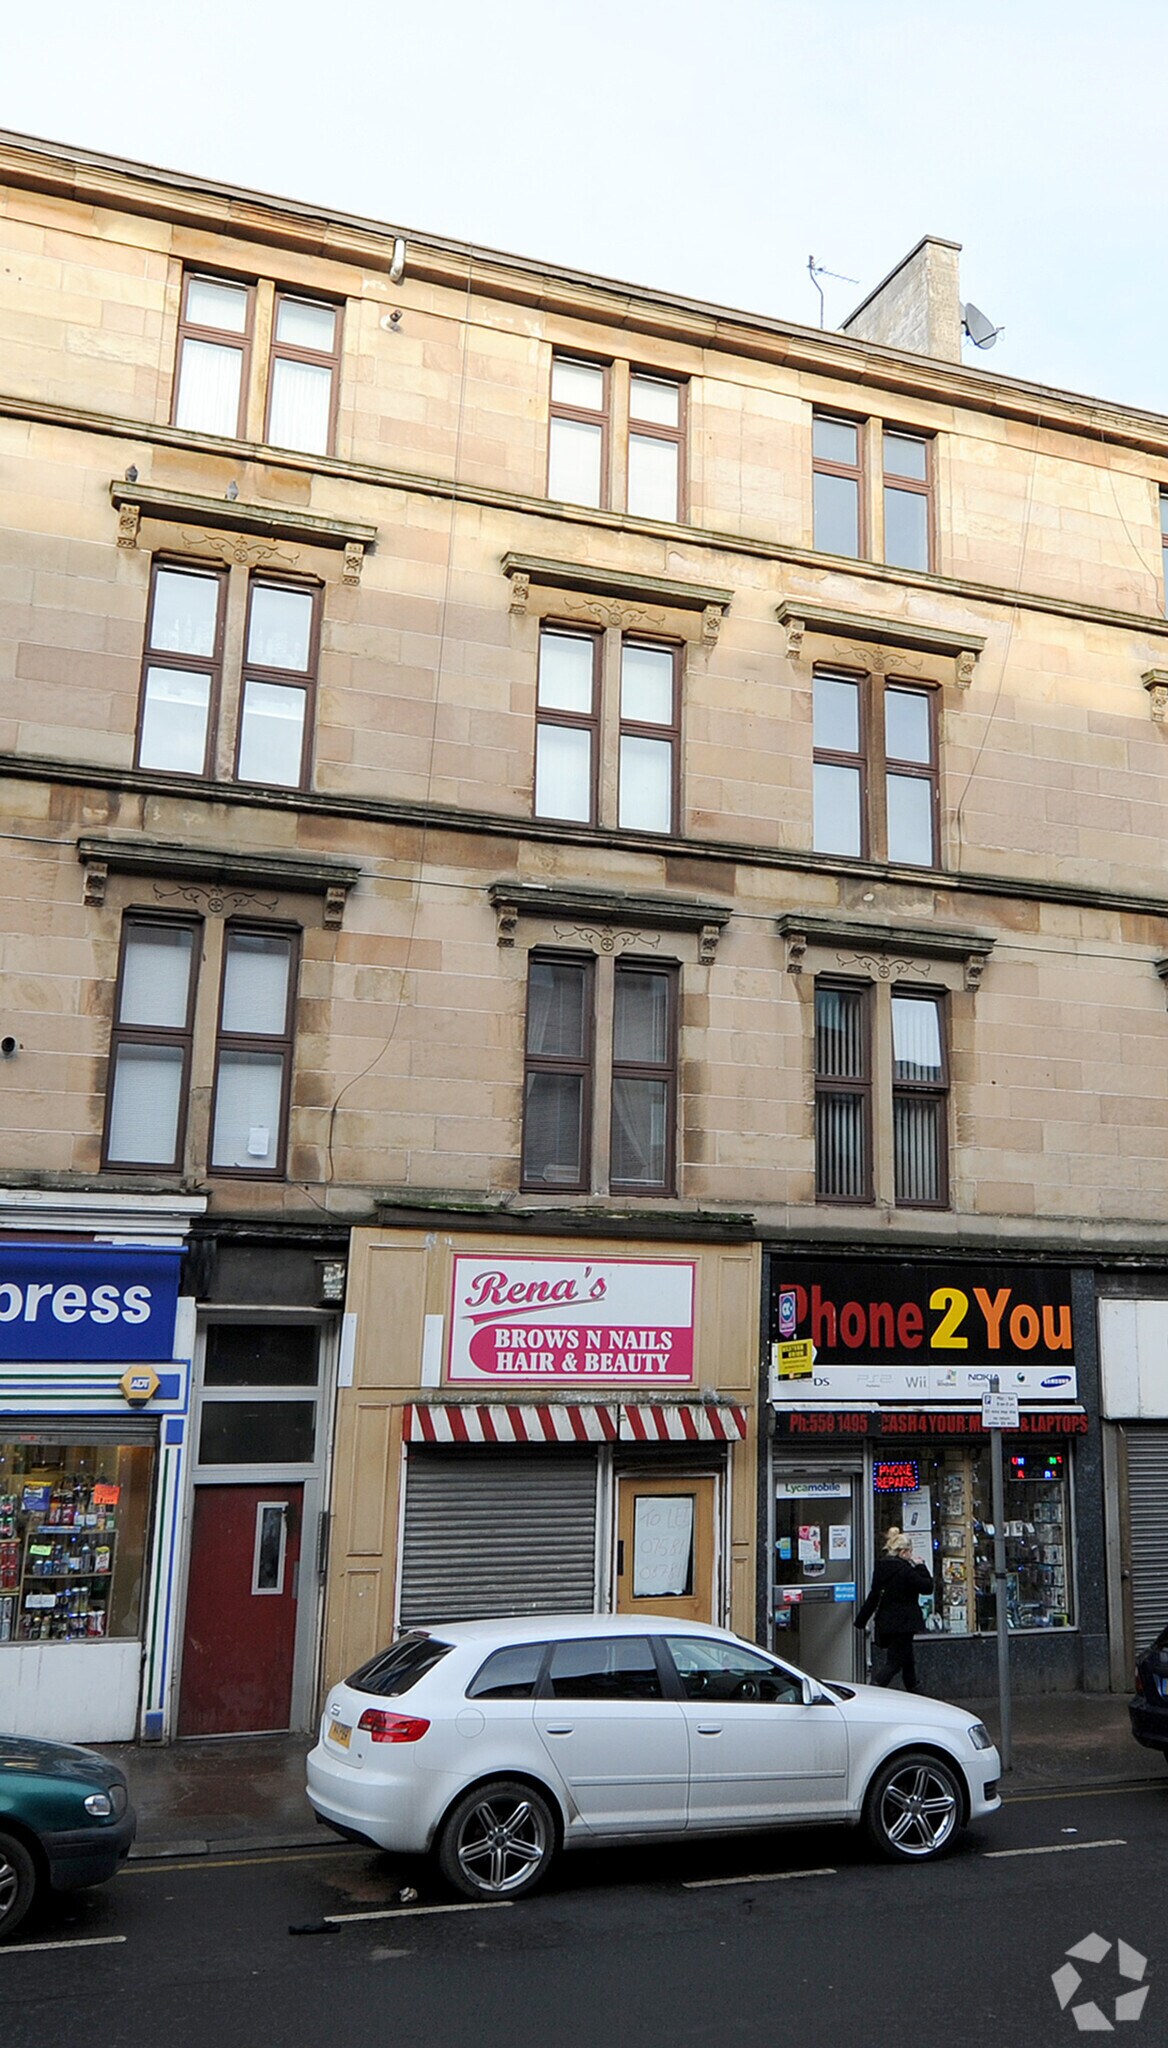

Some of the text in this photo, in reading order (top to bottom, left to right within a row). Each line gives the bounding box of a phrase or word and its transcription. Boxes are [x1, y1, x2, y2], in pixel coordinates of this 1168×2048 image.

[465, 1266, 608, 1307] Rena's
[494, 1328, 673, 1350] BROWS N NAILS
[496, 1352, 670, 1373] HAIR & BEAUTY
[131, 1378, 150, 1390] ADT
[905, 1376, 927, 1388] Wii
[1030, 1414, 1089, 1432] LAPTOPS
[878, 1464, 914, 1476] PHONE
[785, 1482, 841, 1494] Lycamobile
[876, 1476, 916, 1488] REPAIRS
